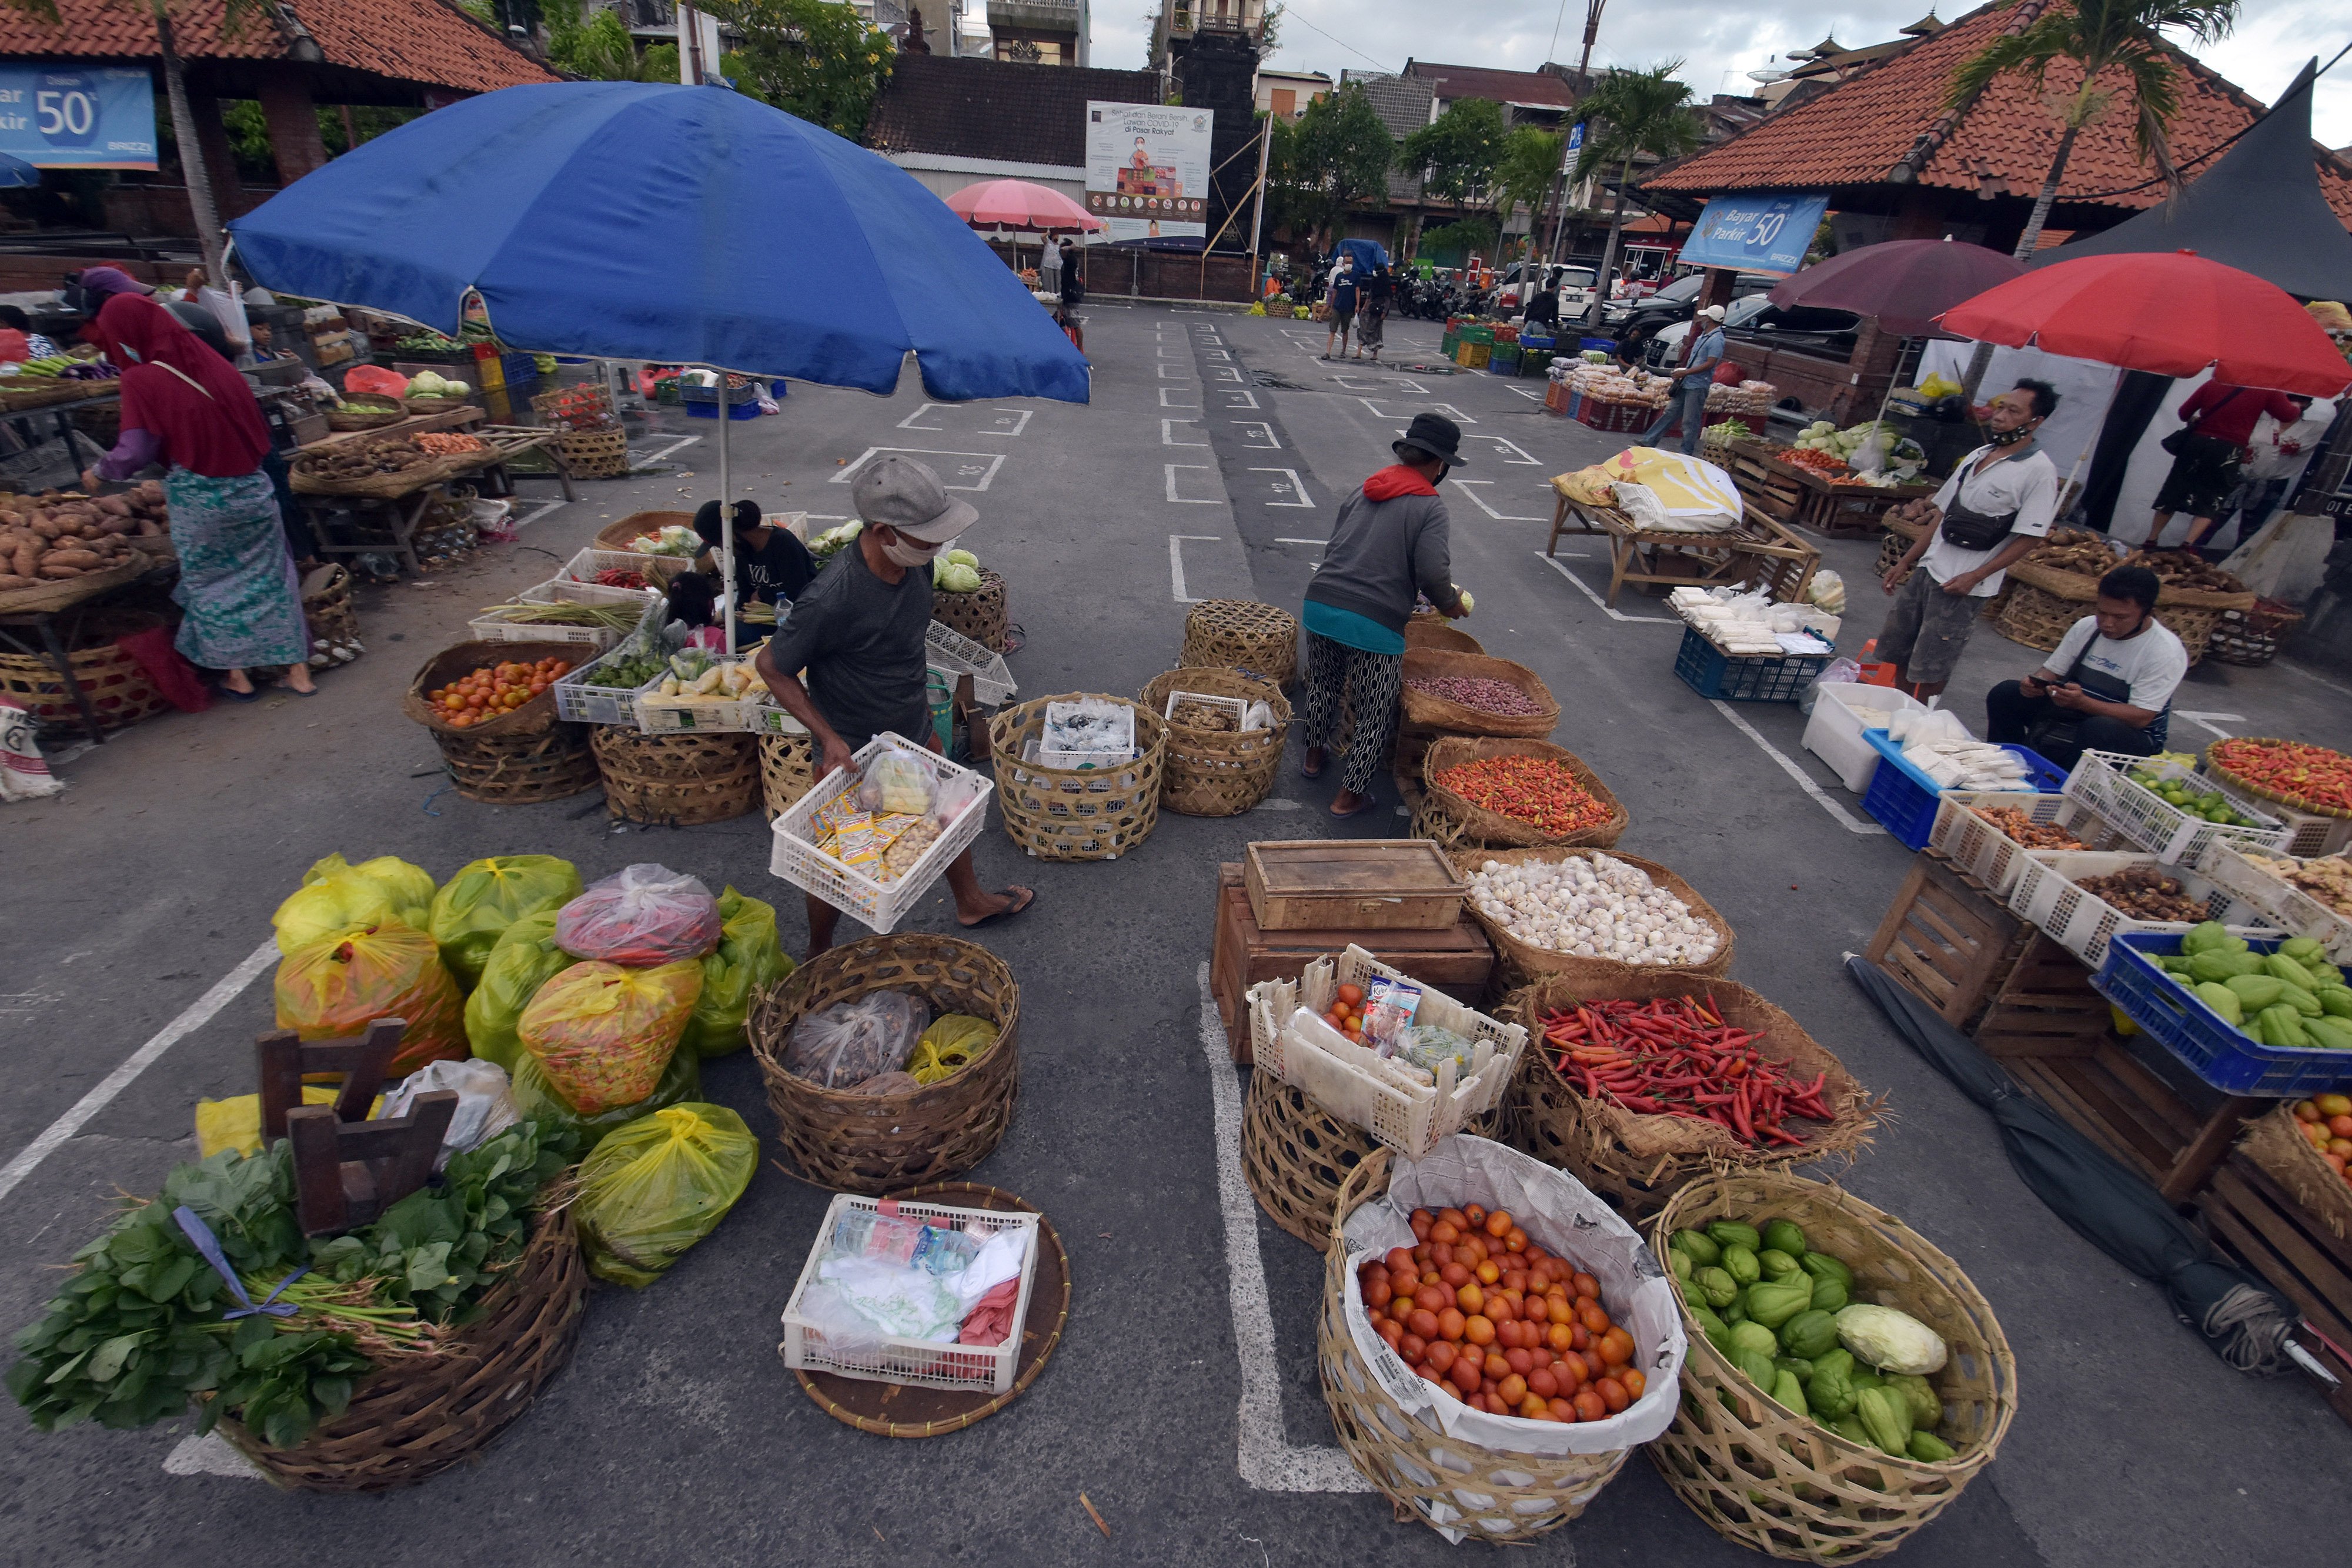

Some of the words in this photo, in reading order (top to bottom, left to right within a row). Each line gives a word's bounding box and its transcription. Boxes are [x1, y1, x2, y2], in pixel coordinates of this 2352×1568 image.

[1111, 109, 1130, 118] Sehat
[1152, 128, 1174, 136] Rakyat
[1569, 128, 1576, 148] P
[1725, 209, 1760, 225] Bayar
[1712, 227, 1747, 241] Parkir
[1770, 253, 1798, 264] BRIZZI
